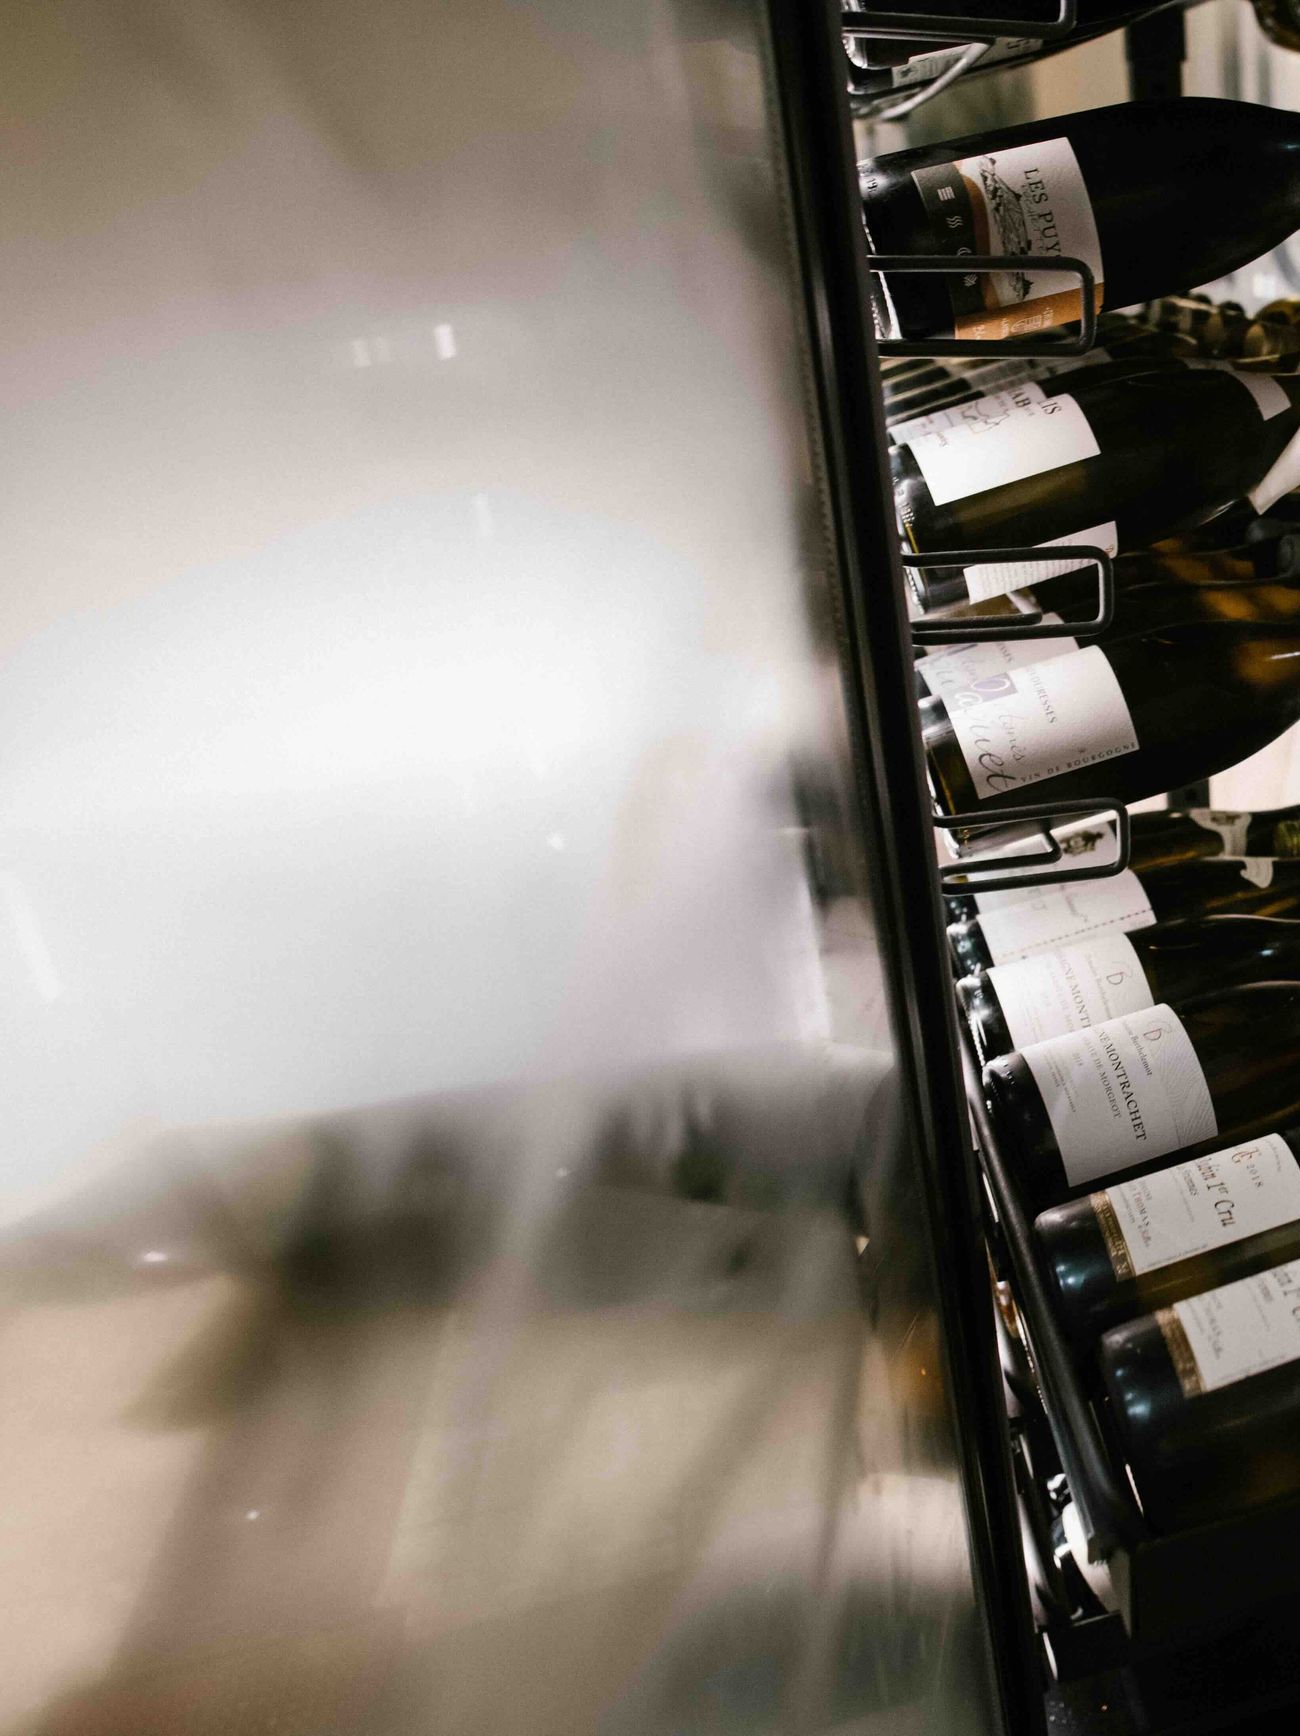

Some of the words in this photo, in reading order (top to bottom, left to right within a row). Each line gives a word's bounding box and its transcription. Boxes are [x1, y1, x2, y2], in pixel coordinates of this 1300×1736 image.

[1023, 167, 1049, 205] LES
[1037, 211, 1062, 258] PUY
[1020, 771, 1041, 783] VIN
[1047, 765, 1061, 775] DE
[1213, 1199, 1237, 1228] Cru
